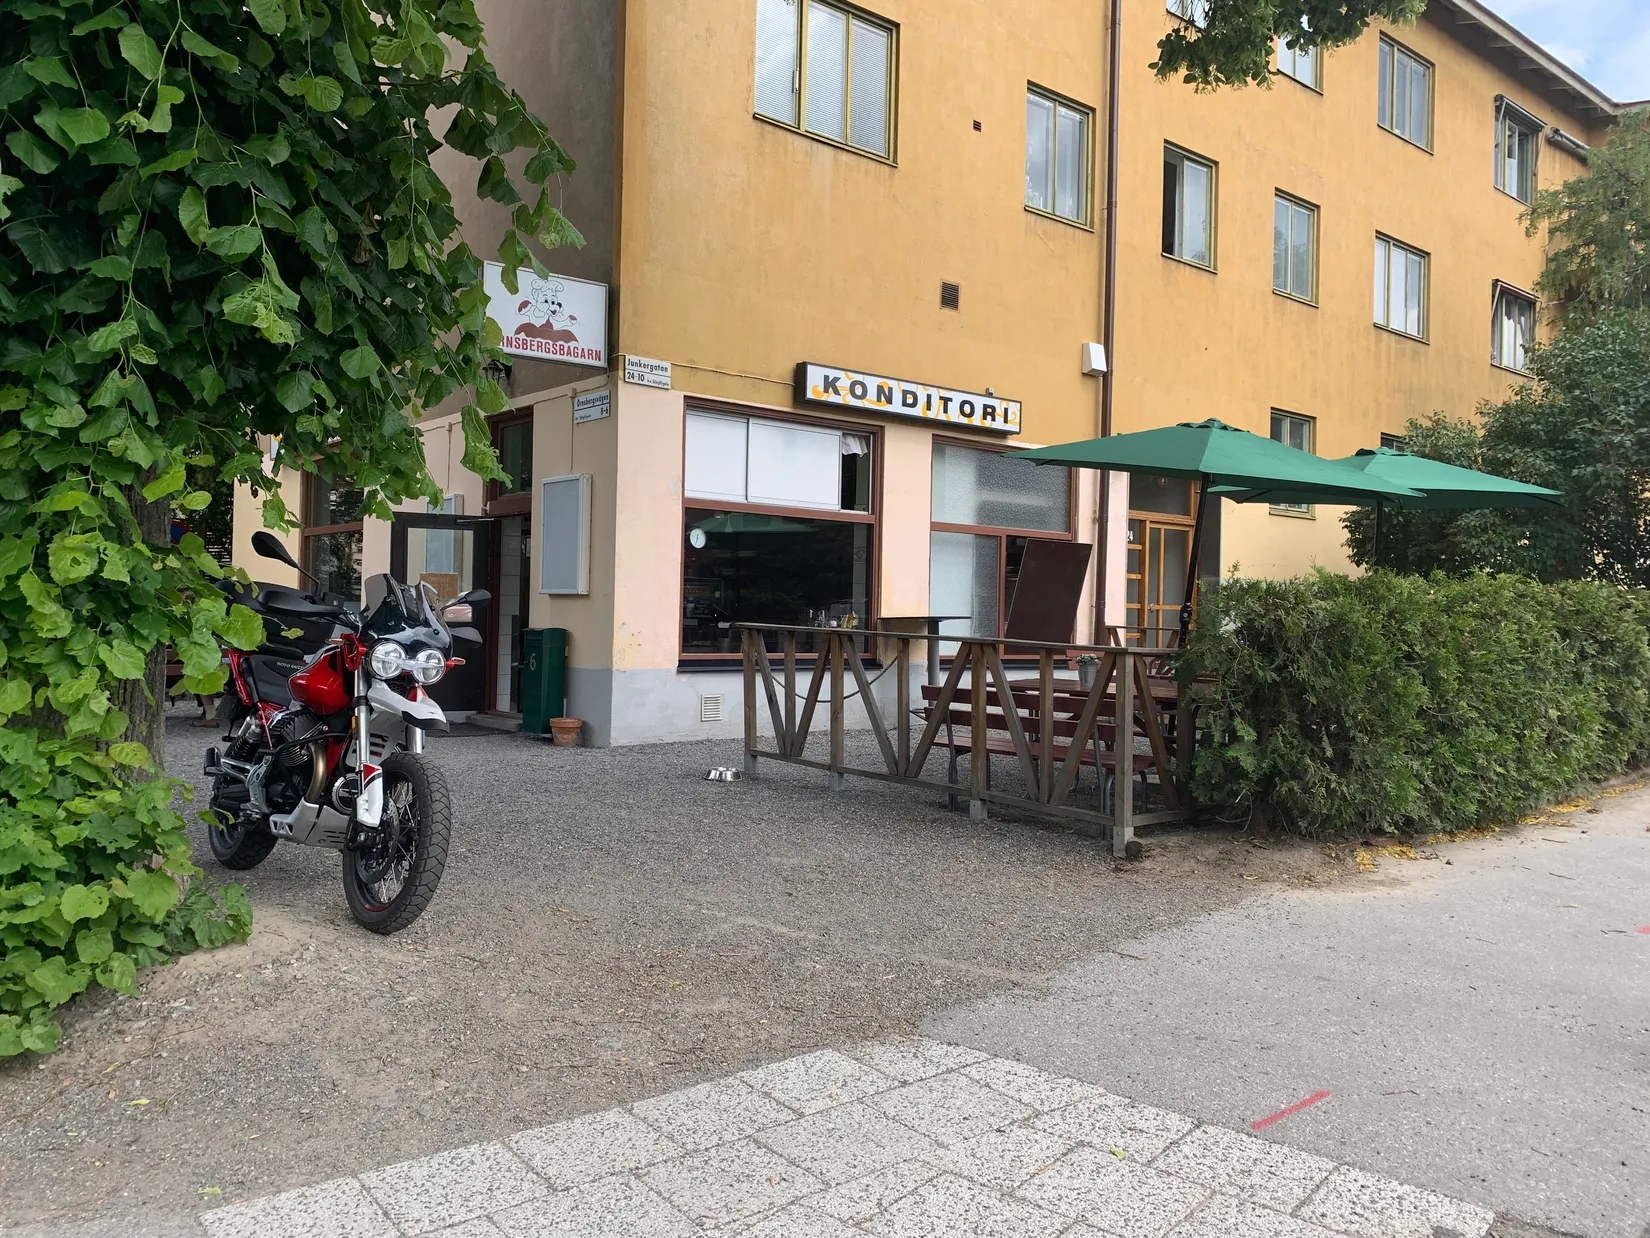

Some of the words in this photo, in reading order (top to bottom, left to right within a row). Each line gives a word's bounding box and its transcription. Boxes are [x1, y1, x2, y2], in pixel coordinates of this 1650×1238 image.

[501, 335, 602, 362] NSBERGSBAGARN
[627, 357, 669, 373] Junkergatan
[626, 371, 645, 382] 24-10
[823, 374, 1009, 424] KONDITORI
[529, 652, 537, 671] 6
